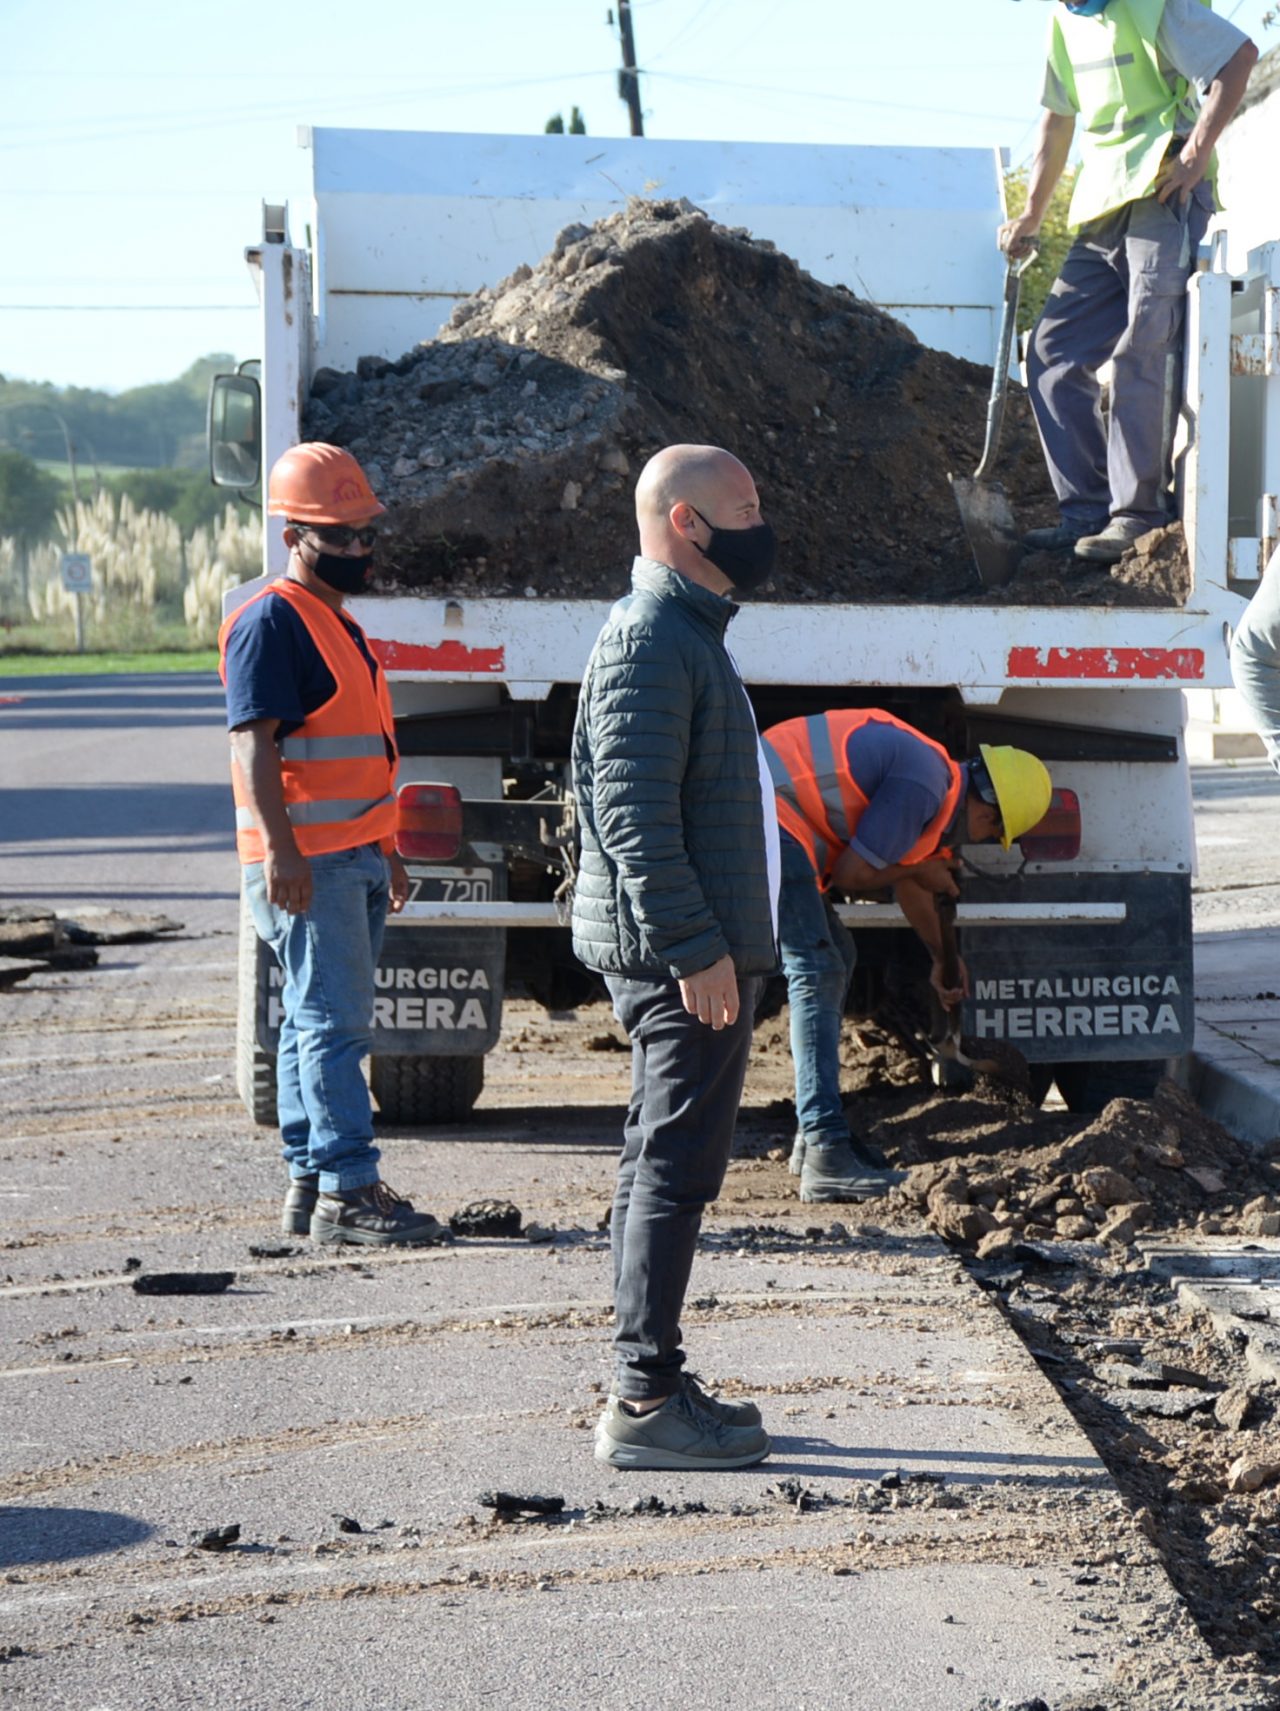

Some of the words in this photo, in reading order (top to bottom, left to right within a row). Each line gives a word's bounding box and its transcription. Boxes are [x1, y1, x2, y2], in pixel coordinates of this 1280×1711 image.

[440, 880, 488, 902] 720
[269, 966, 489, 990] MURGICA
[975, 975, 1181, 1000] METALURGICA
[268, 996, 488, 1030] HRERA
[975, 1004, 1181, 1039] HERRERA
